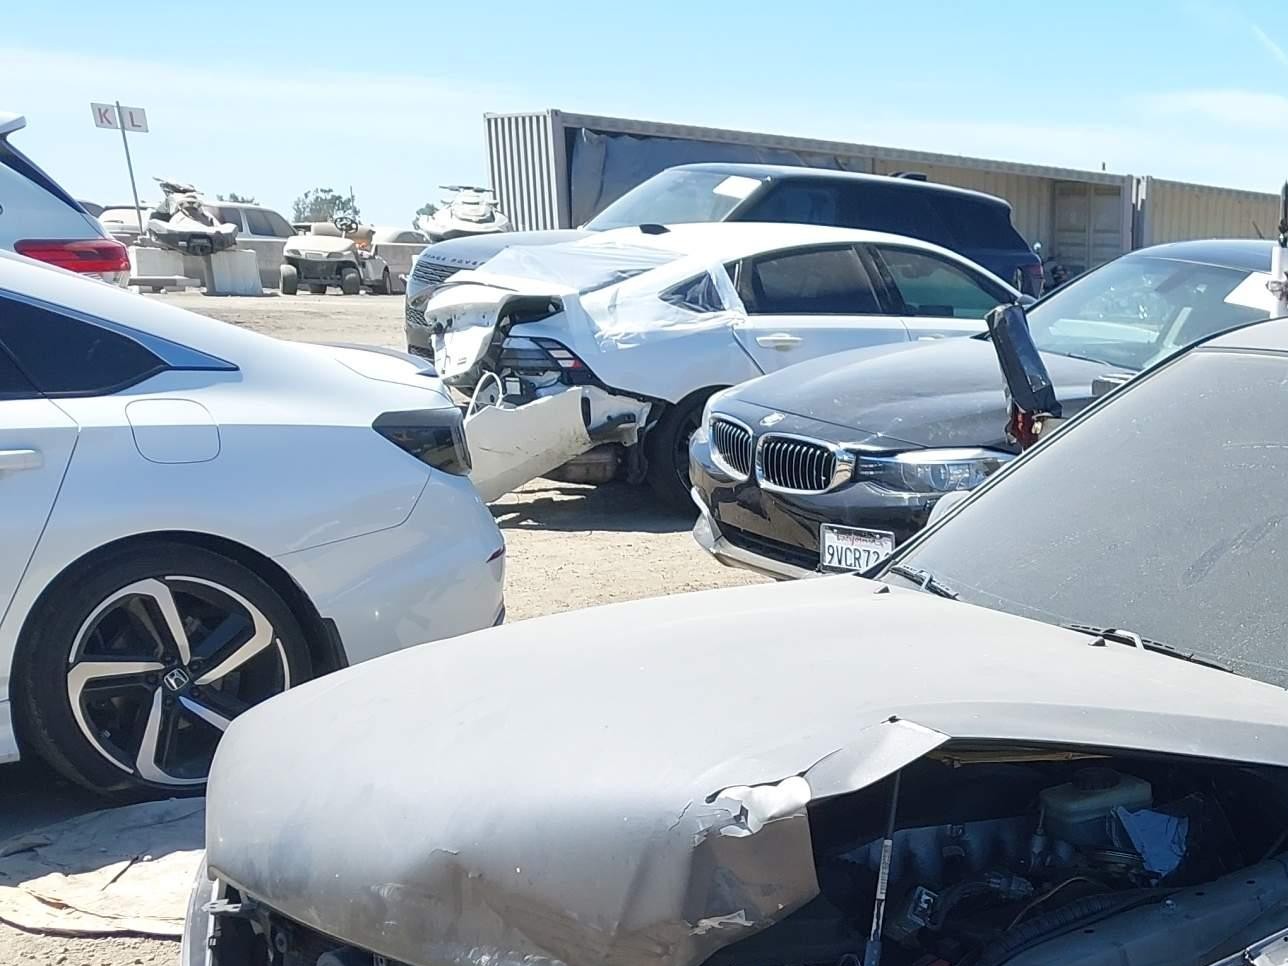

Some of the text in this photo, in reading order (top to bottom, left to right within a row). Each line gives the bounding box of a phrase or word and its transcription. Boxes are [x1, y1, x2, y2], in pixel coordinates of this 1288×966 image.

[97, 107, 112, 125] K
[129, 111, 142, 128] L
[827, 544, 890, 568] 9VCR72
